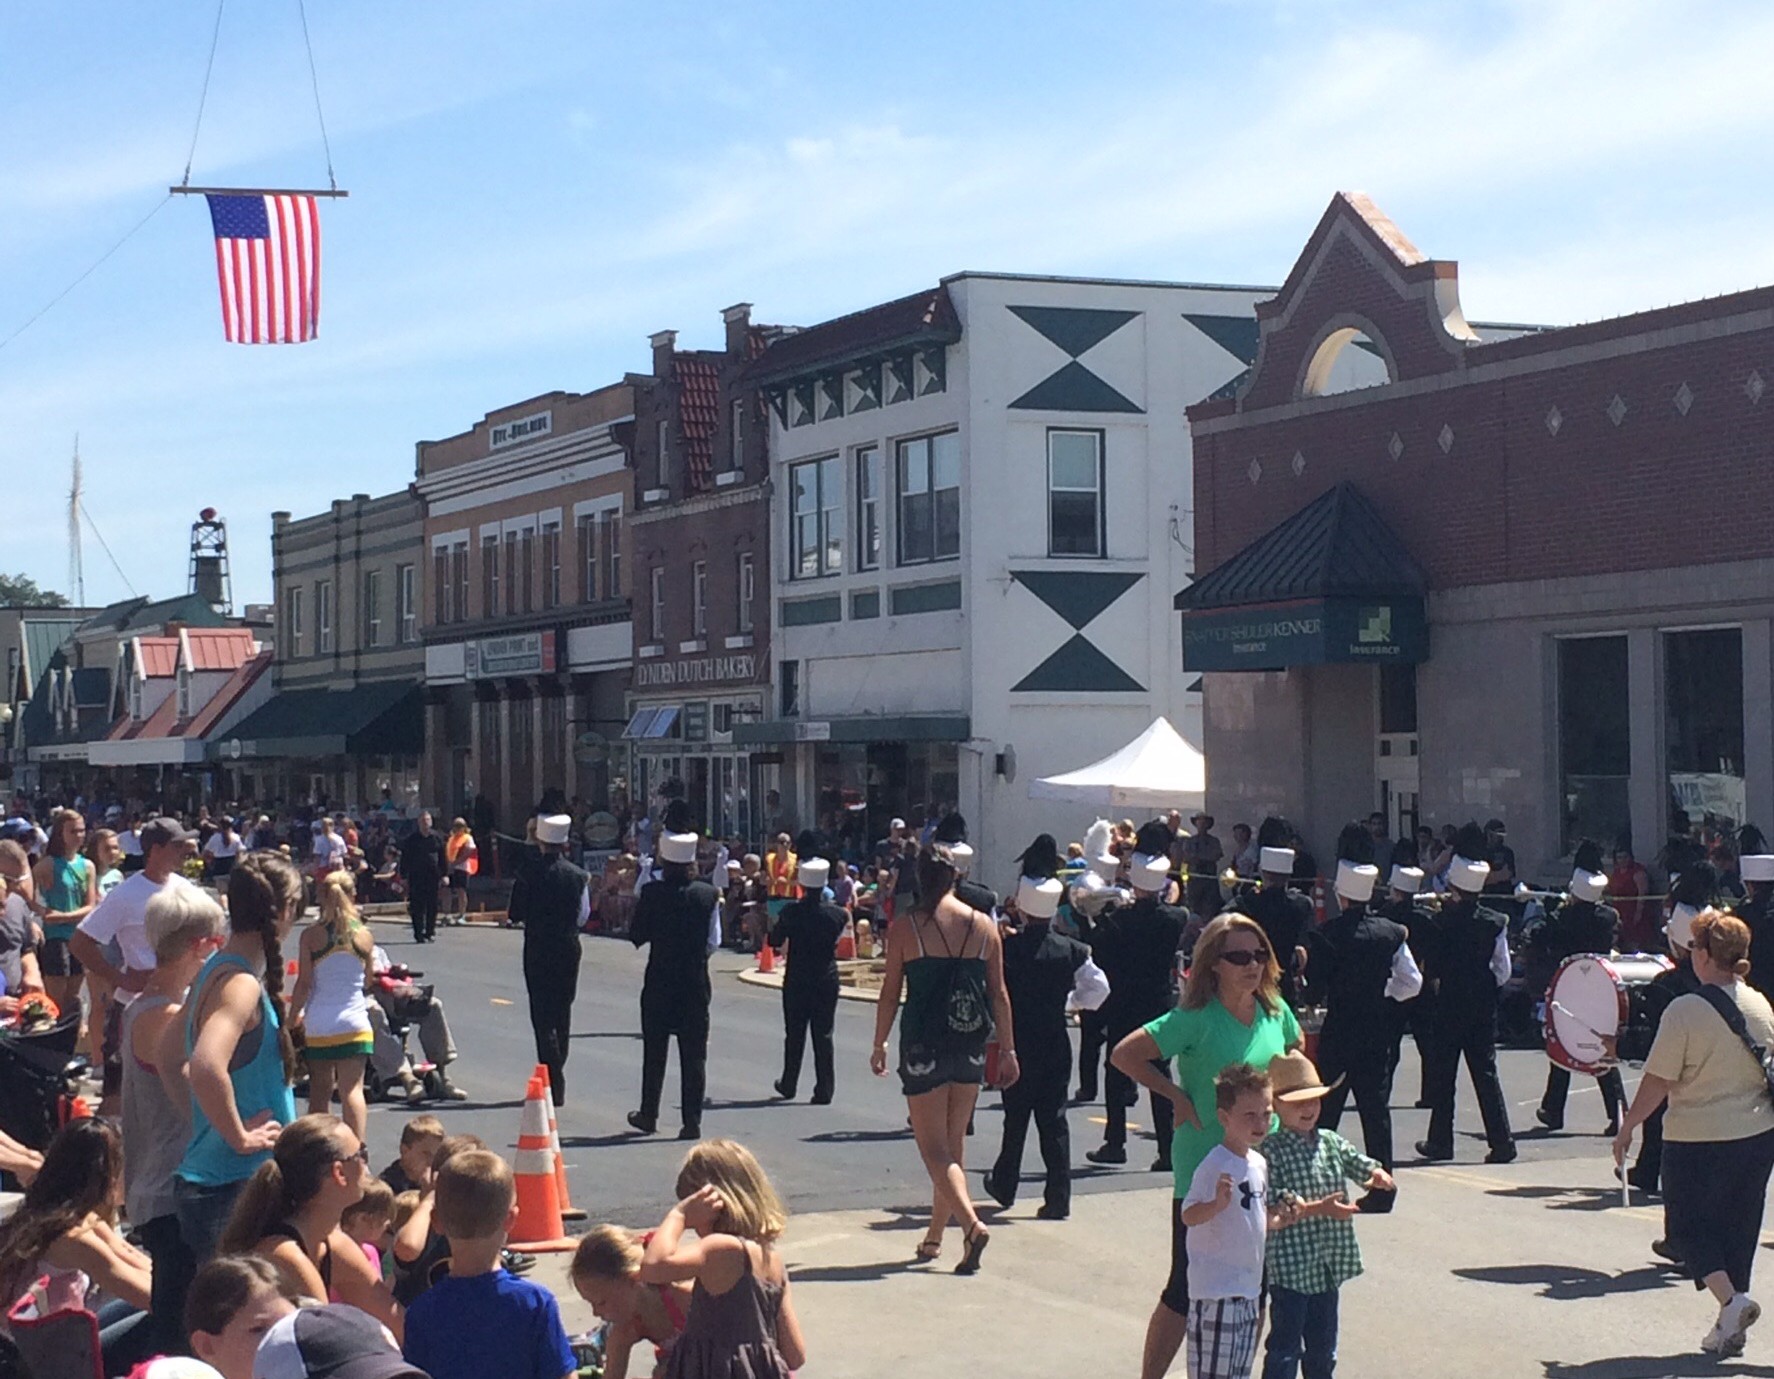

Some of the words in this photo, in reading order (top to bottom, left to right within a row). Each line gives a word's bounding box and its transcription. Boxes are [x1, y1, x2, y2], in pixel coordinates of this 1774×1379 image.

[1273, 618, 1321, 636] KENNER
[678, 658, 714, 682] DUTCH
[716, 655, 756, 680] BAKERY
